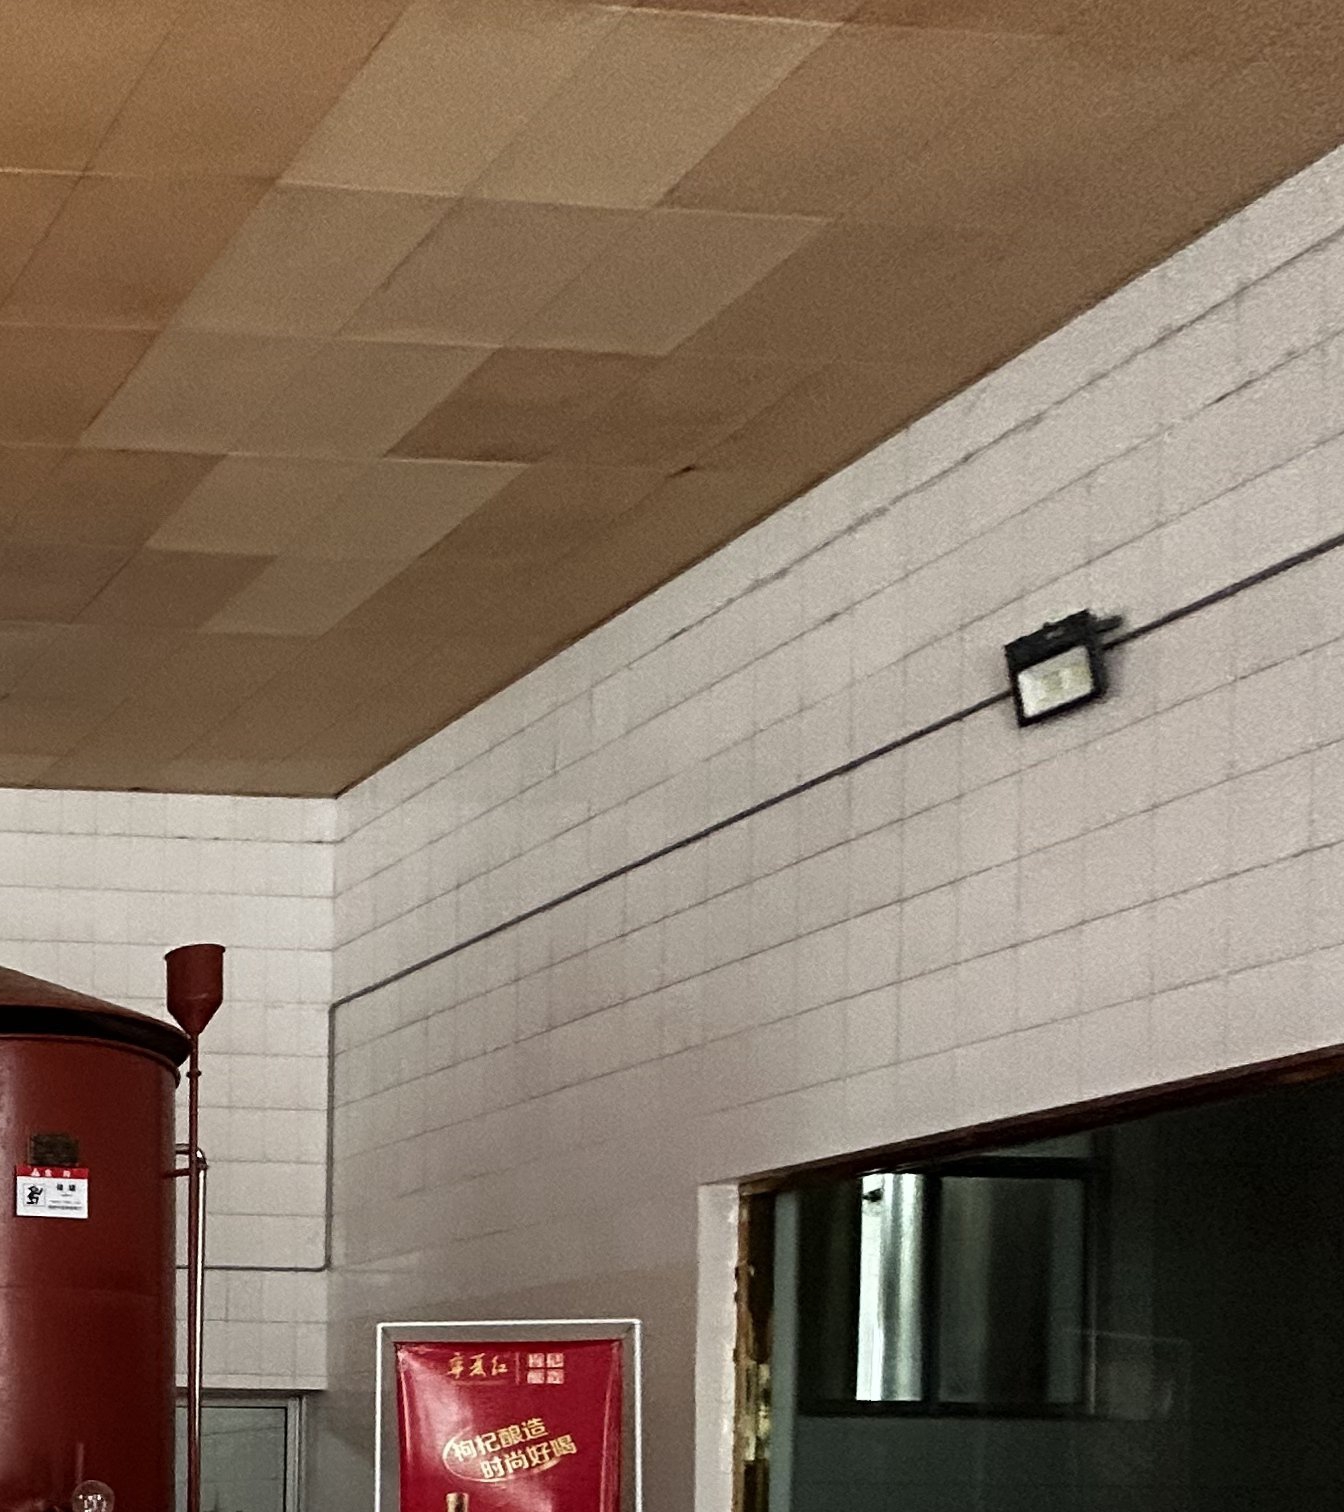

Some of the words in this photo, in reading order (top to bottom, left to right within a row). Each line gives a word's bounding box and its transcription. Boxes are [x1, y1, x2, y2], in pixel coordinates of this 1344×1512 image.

[452, 1417, 549, 1462] 枸杞酿造
[480, 1434, 577, 1479] 时尚好喝
